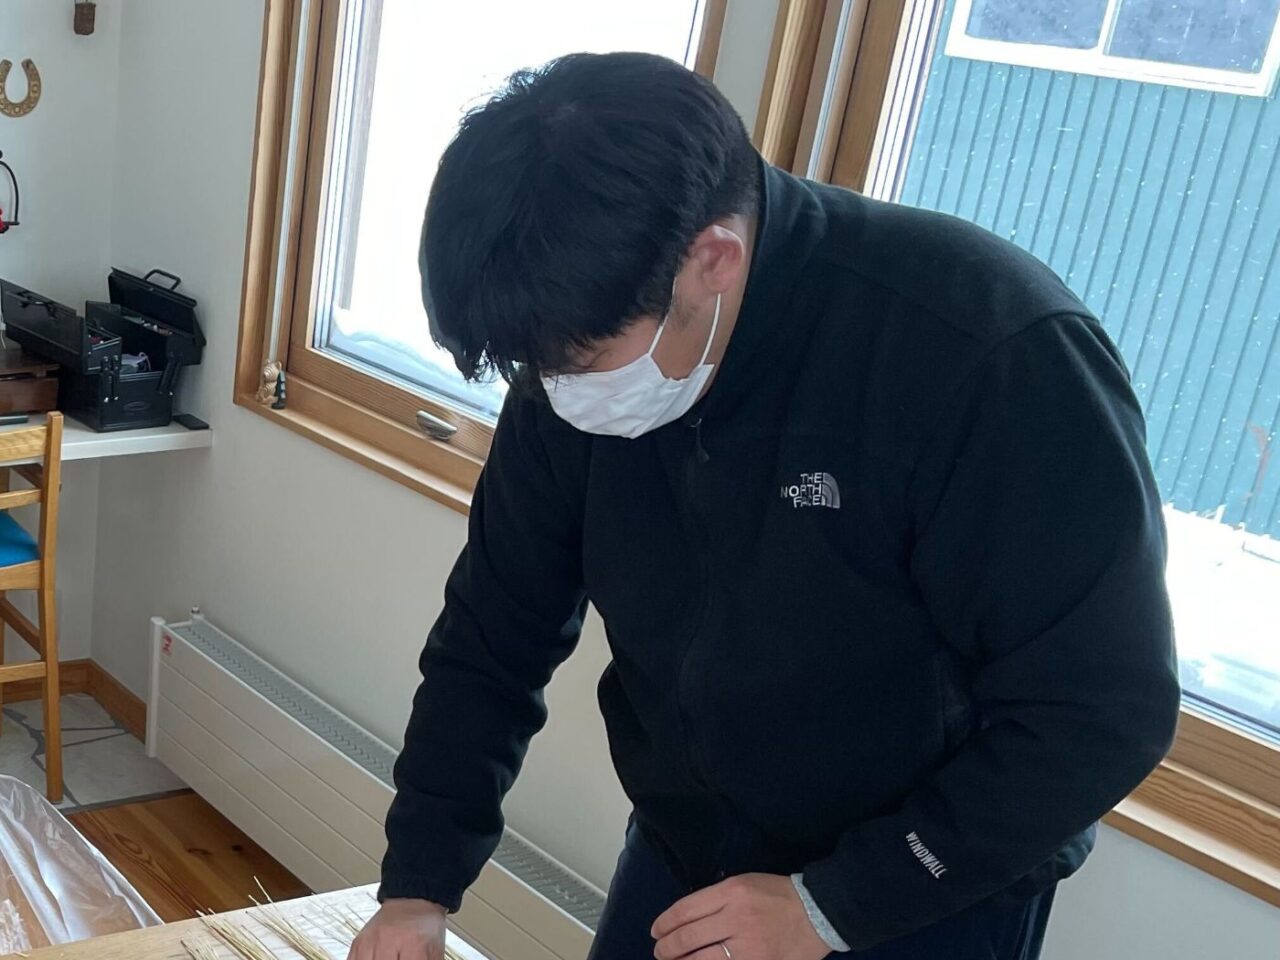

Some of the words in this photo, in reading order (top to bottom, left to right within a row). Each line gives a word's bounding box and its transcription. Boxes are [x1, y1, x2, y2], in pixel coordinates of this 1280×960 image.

[800, 472, 823, 484] THE
[780, 483, 822, 499] NORTH
[793, 494, 822, 508] FACE
[905, 831, 948, 879] WINDWALL
